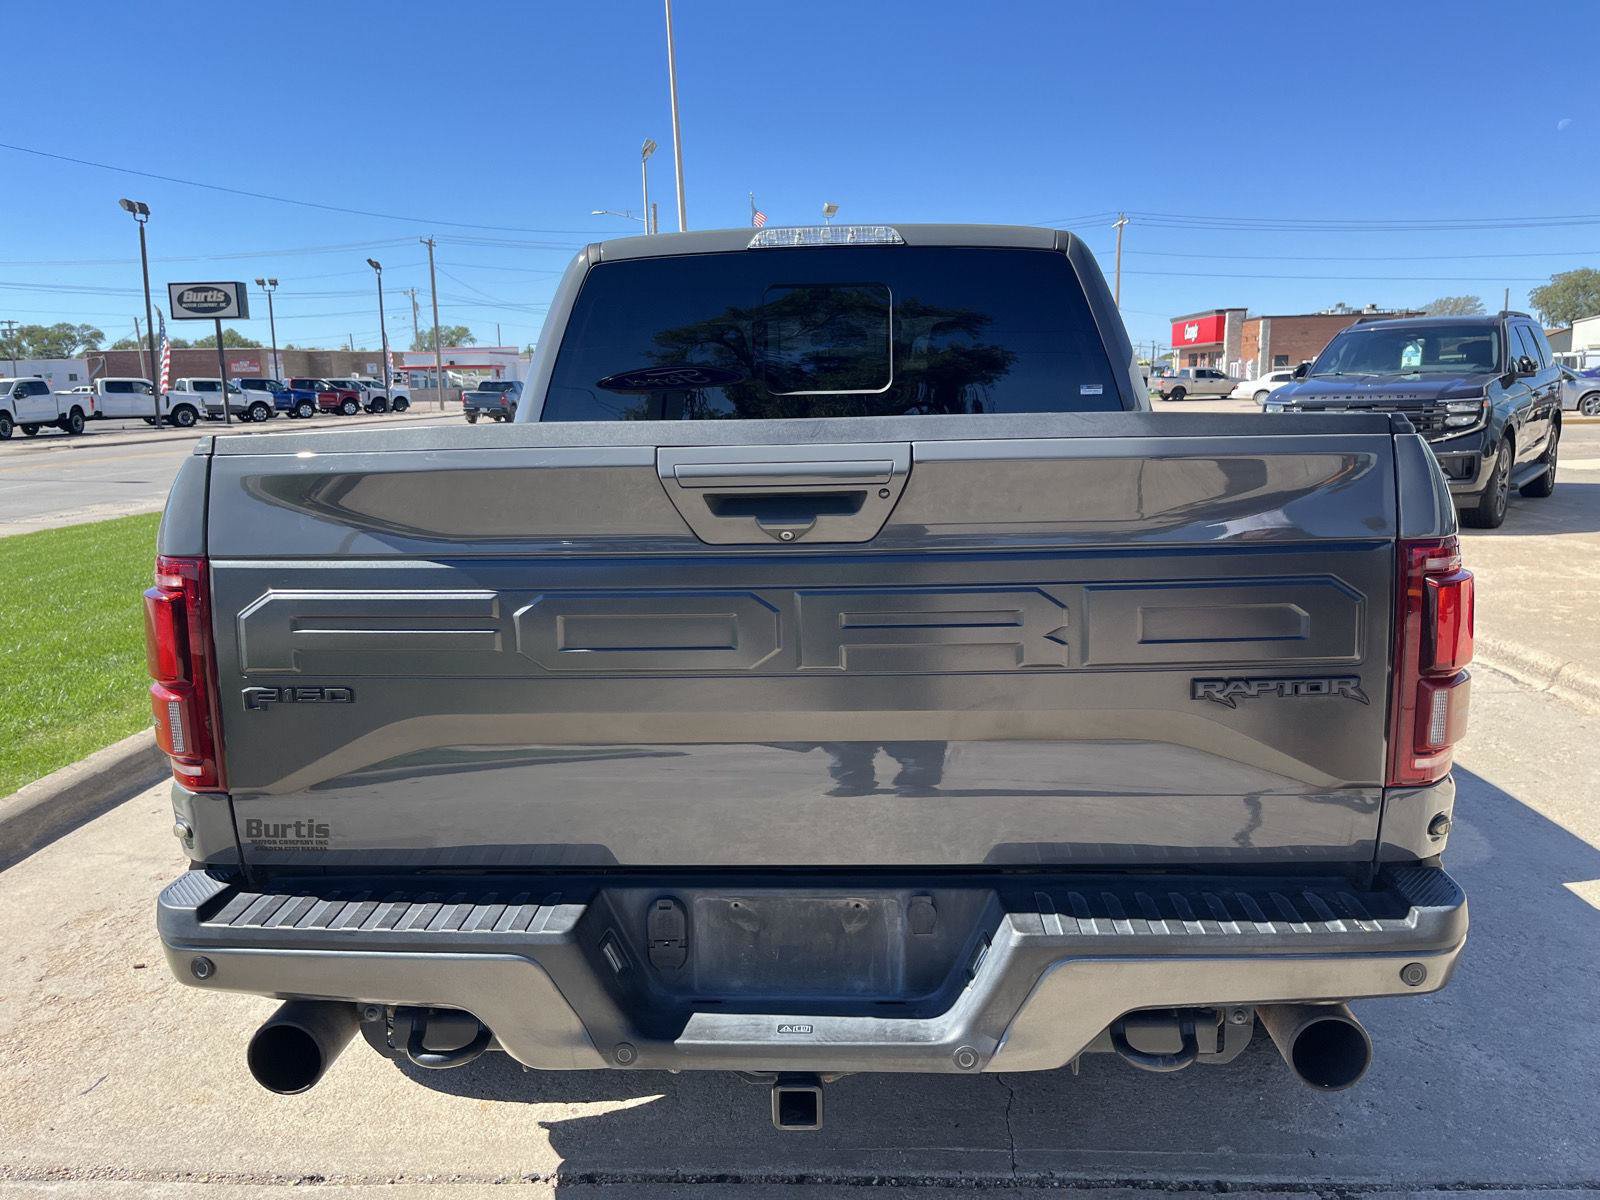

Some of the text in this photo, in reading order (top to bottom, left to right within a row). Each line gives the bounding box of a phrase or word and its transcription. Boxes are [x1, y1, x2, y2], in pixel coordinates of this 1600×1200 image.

[182, 290, 226, 303] Burtis
[237, 574, 1366, 676] FORD
[1190, 675, 1370, 709] RAPTOR
[246, 818, 330, 838] Burtis
